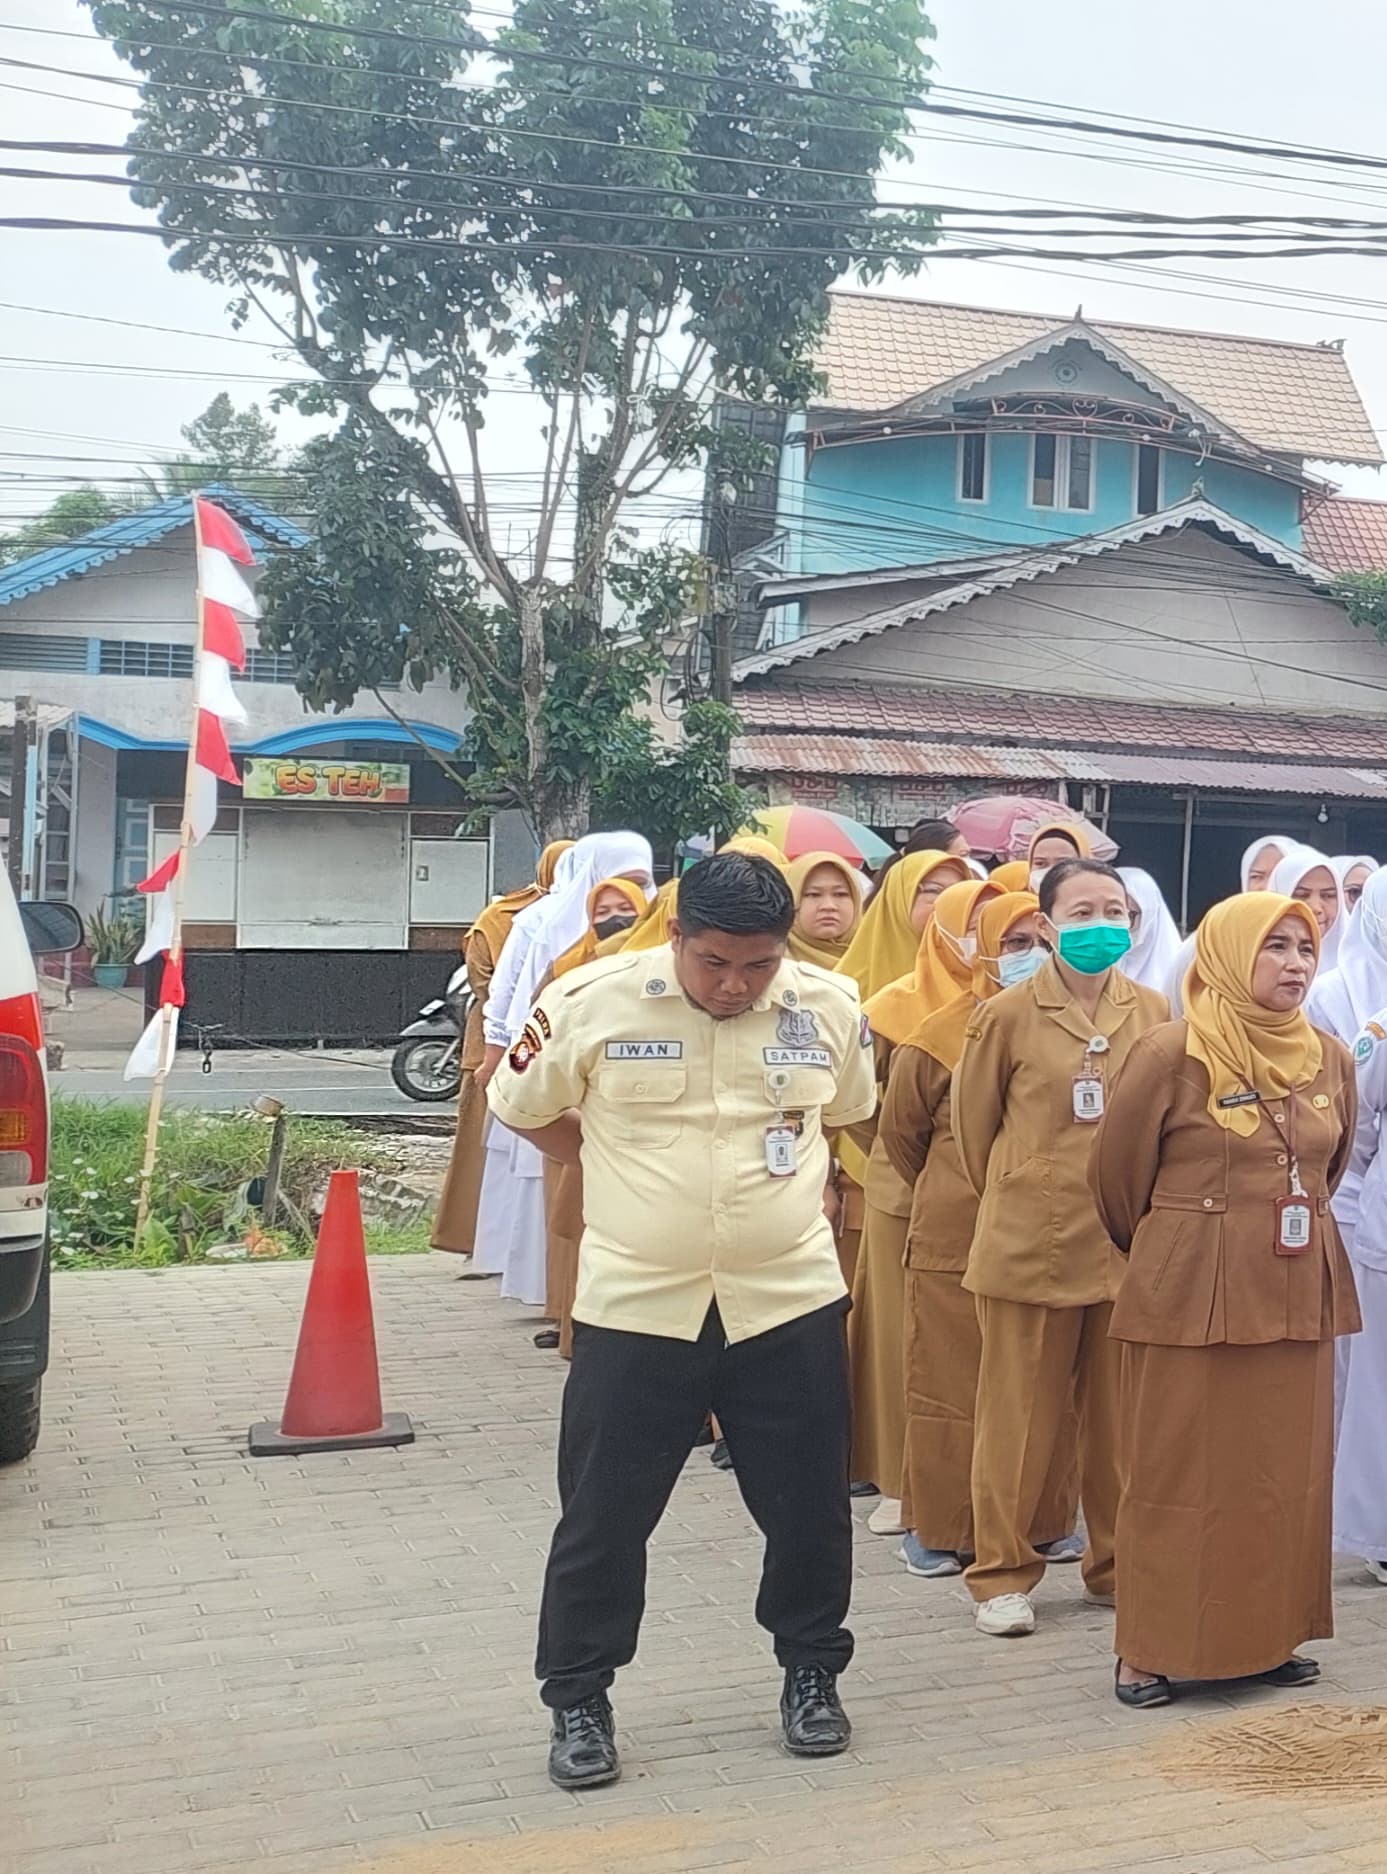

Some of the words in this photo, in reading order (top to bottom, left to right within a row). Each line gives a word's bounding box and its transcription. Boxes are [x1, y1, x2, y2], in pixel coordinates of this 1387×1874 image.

[276, 764, 316, 794] ES
[322, 766, 381, 796] TEH
[619, 1043, 669, 1057] IWAN
[770, 1051, 828, 1065] SATPAM
